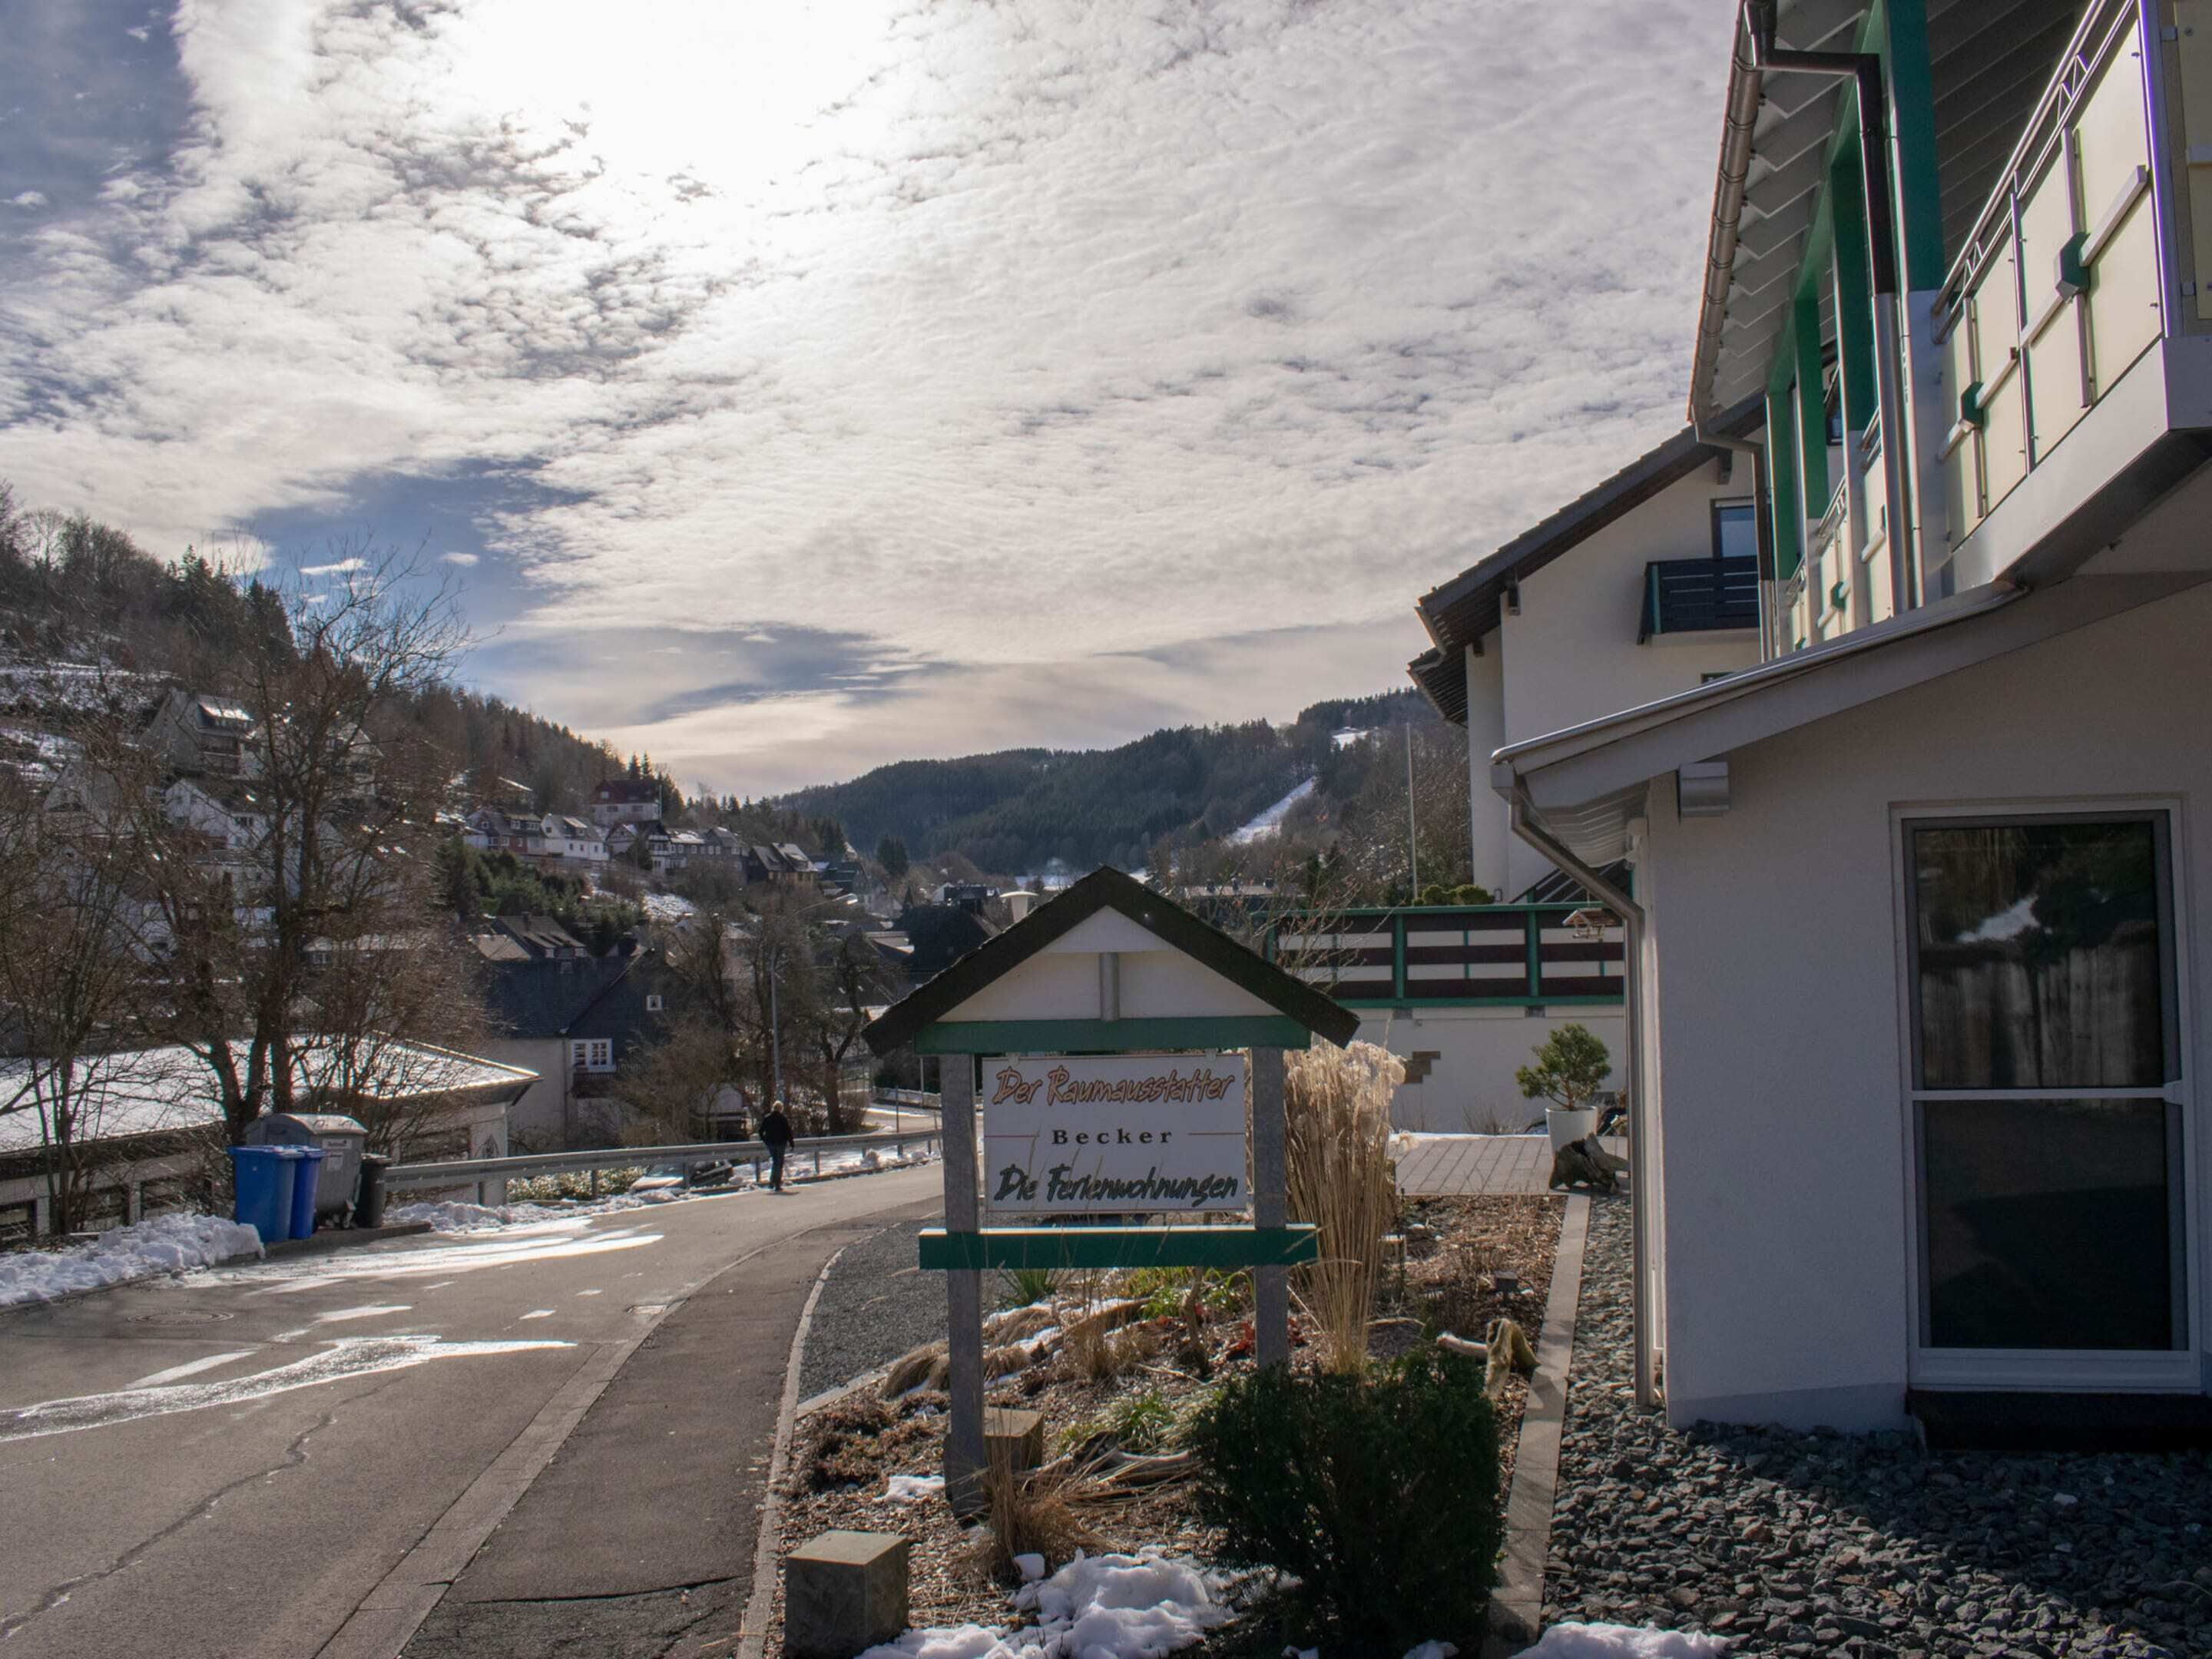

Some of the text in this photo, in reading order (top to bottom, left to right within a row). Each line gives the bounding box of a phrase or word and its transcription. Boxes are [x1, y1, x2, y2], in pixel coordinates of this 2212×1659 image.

[992, 1065, 1235, 1106] Der Raumausstatter
[1052, 1128, 1173, 1144] Becker
[994, 1163, 1238, 1207] Die Ferienwohnungen
